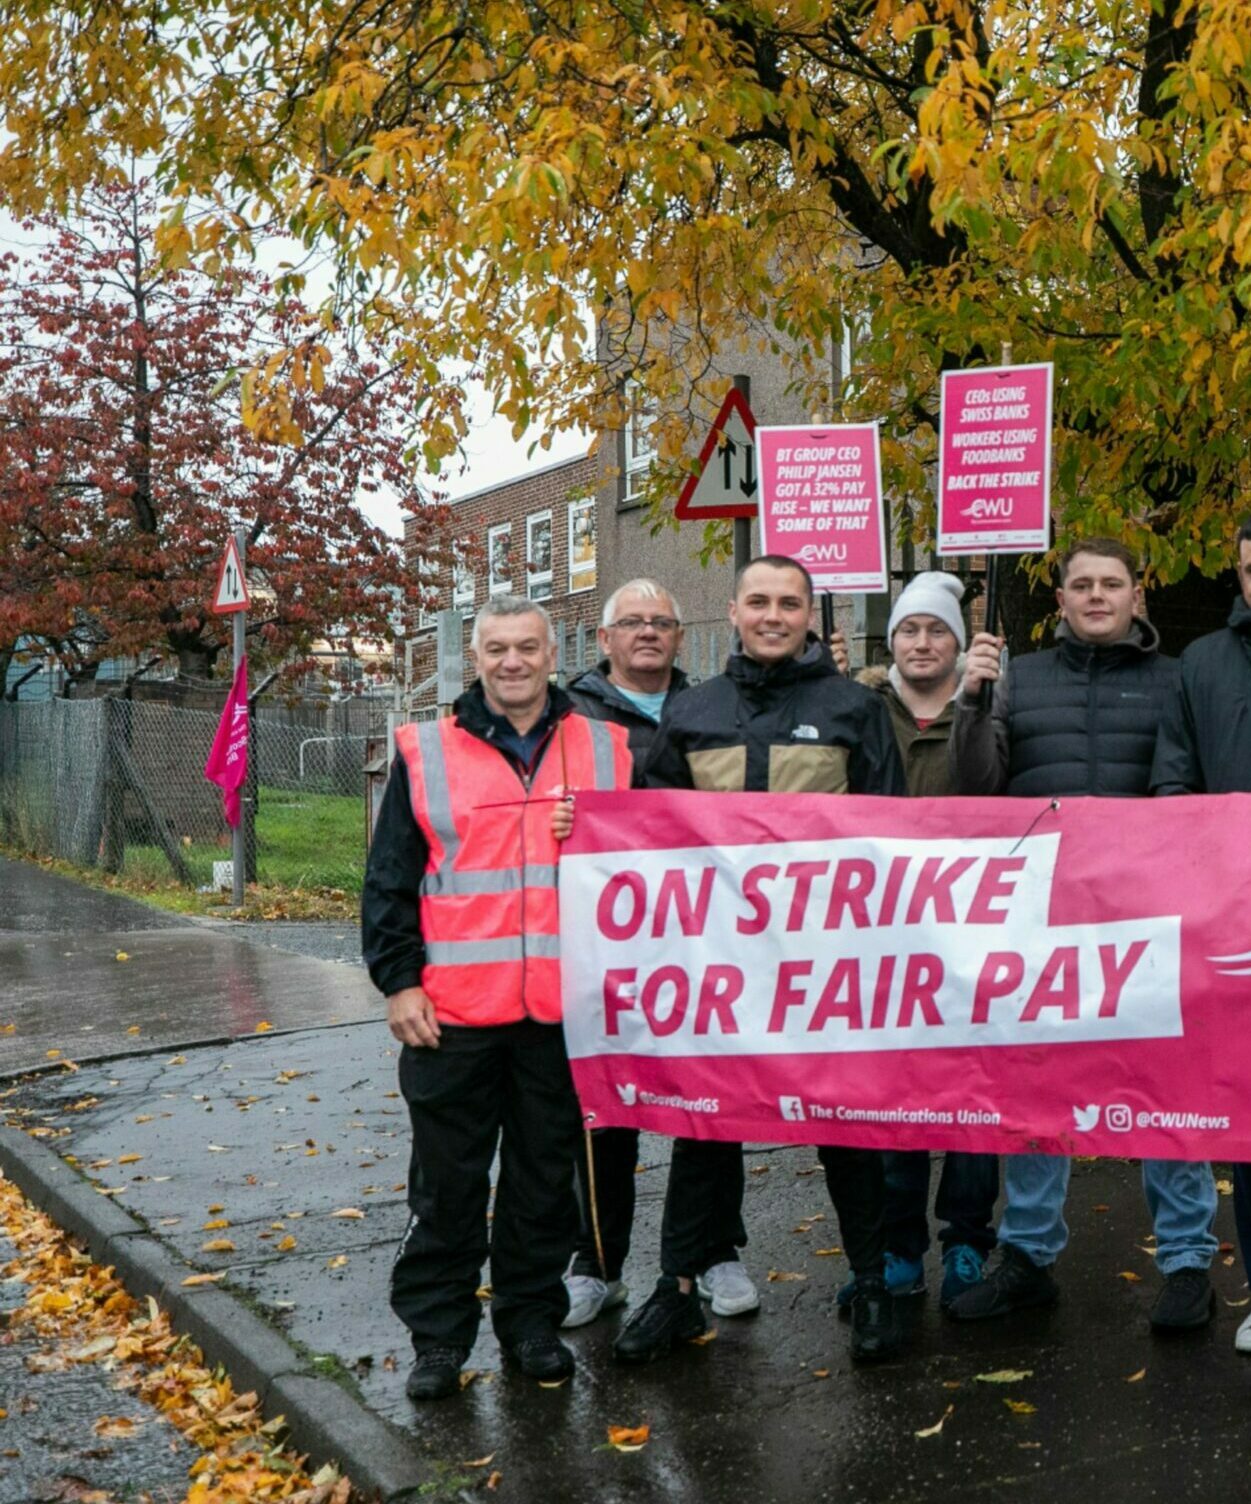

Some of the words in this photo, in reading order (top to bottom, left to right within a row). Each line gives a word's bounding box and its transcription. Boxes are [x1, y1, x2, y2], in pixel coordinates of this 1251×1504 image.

[965, 389, 991, 405] CEOs
[992, 386, 1027, 402] USING
[960, 406, 993, 423] SWISS
[993, 404, 1031, 421] BANKS
[952, 430, 1003, 449] WORKERS
[1003, 428, 1038, 444] USING
[776, 447, 793, 462] BT
[793, 446, 837, 462] GROUP
[837, 446, 861, 460] CEO
[961, 446, 1027, 465] FOODBANKS
[776, 464, 817, 480] PHILIP
[816, 463, 862, 481] JANSEN
[946, 475, 979, 491] BACK
[979, 473, 1001, 488] THE
[1000, 471, 1041, 488] STRIKE
[775, 482, 802, 498] GOT
[802, 482, 811, 496] A
[812, 482, 841, 496] 32%
[841, 481, 866, 495] PAY
[770, 501, 799, 516] RISE
[809, 499, 832, 514] WE
[831, 498, 872, 513] WANT
[971, 497, 1013, 518] CWU
[776, 517, 814, 532] SOME
[815, 517, 835, 531] OF
[835, 516, 869, 531] THAT
[801, 543, 848, 562] CWU
[596, 866, 717, 942] ON
[736, 855, 1028, 935] STRIKE
[602, 964, 746, 1038] FOR
[766, 952, 946, 1033] FAIR
[971, 940, 1152, 1024] PAY
[808, 1104, 834, 1119] The
[835, 1105, 954, 1125] Communications
[956, 1109, 1002, 1126] Union
[1136, 1111, 1231, 1130] @CWUNews
